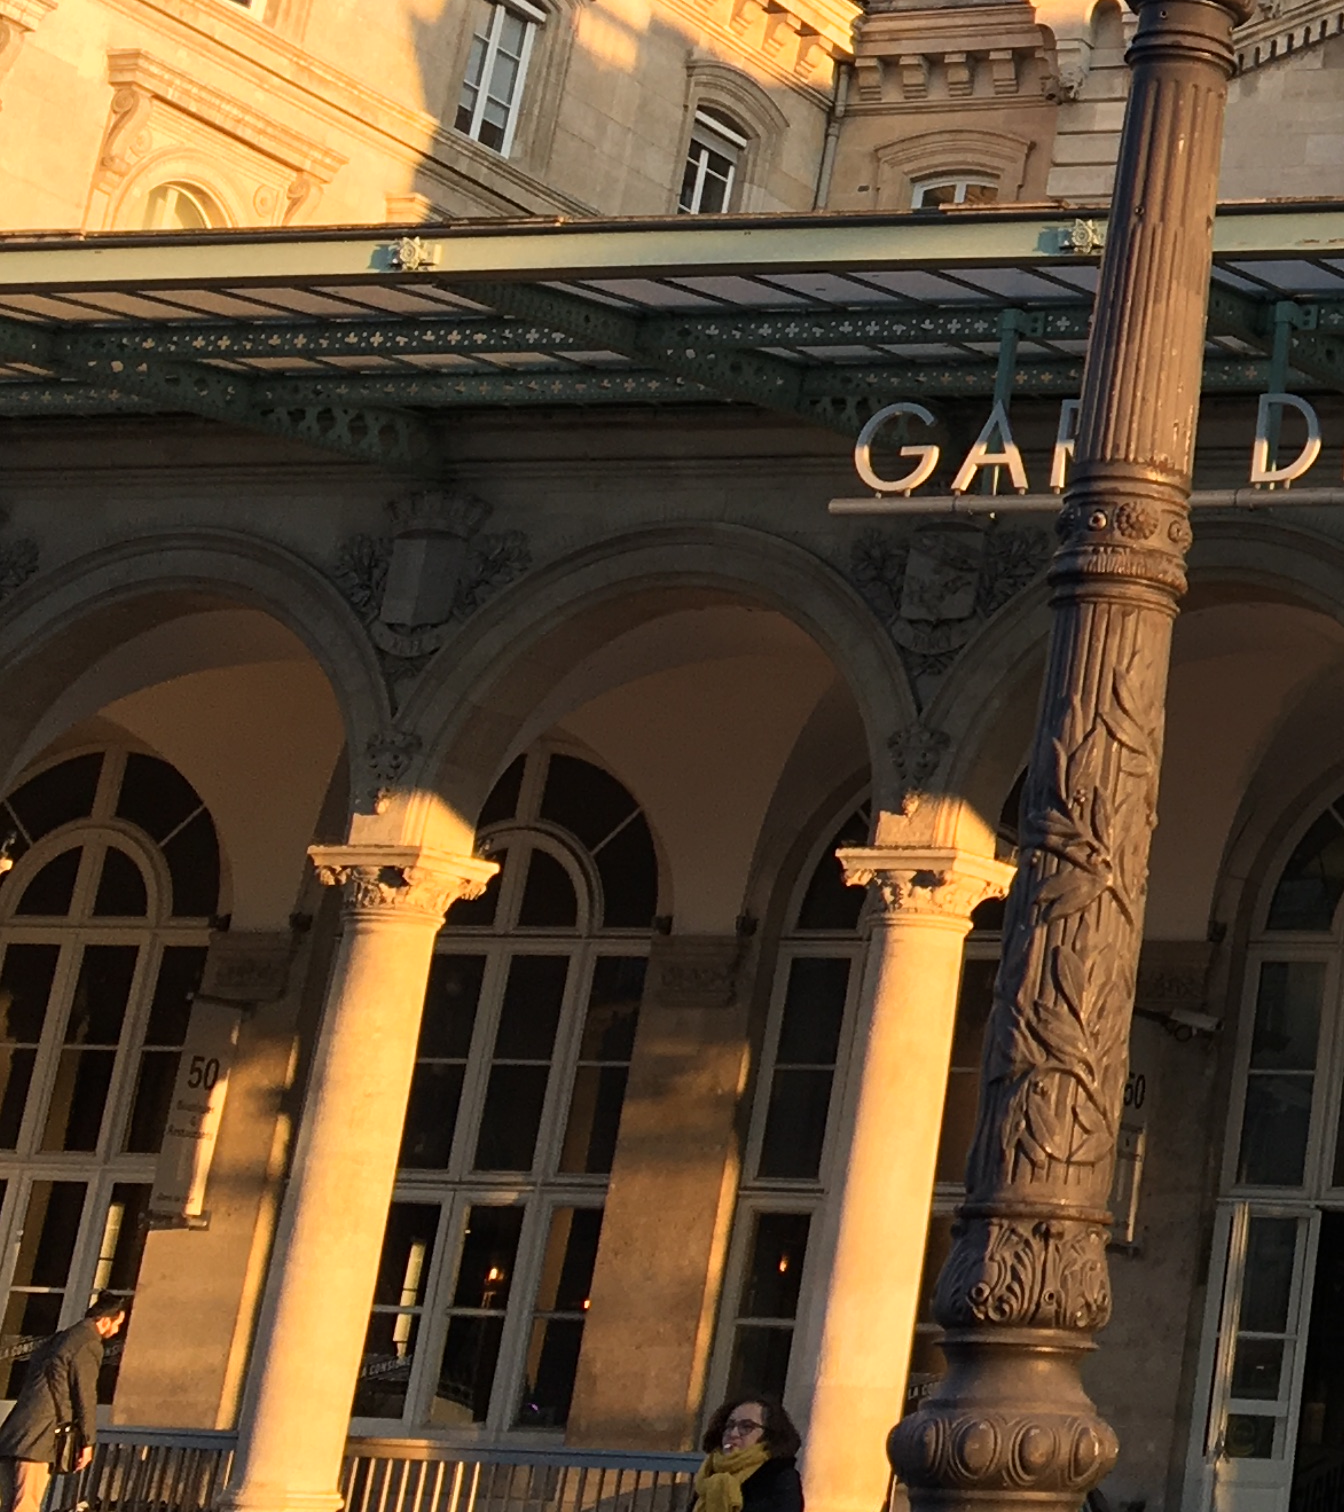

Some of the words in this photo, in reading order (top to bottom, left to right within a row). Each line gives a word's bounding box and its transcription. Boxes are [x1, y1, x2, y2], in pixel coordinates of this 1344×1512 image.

[854, 399, 1082, 492] GA
[187, 1055, 220, 1090] 50
[1124, 1072, 1146, 1110] 50
